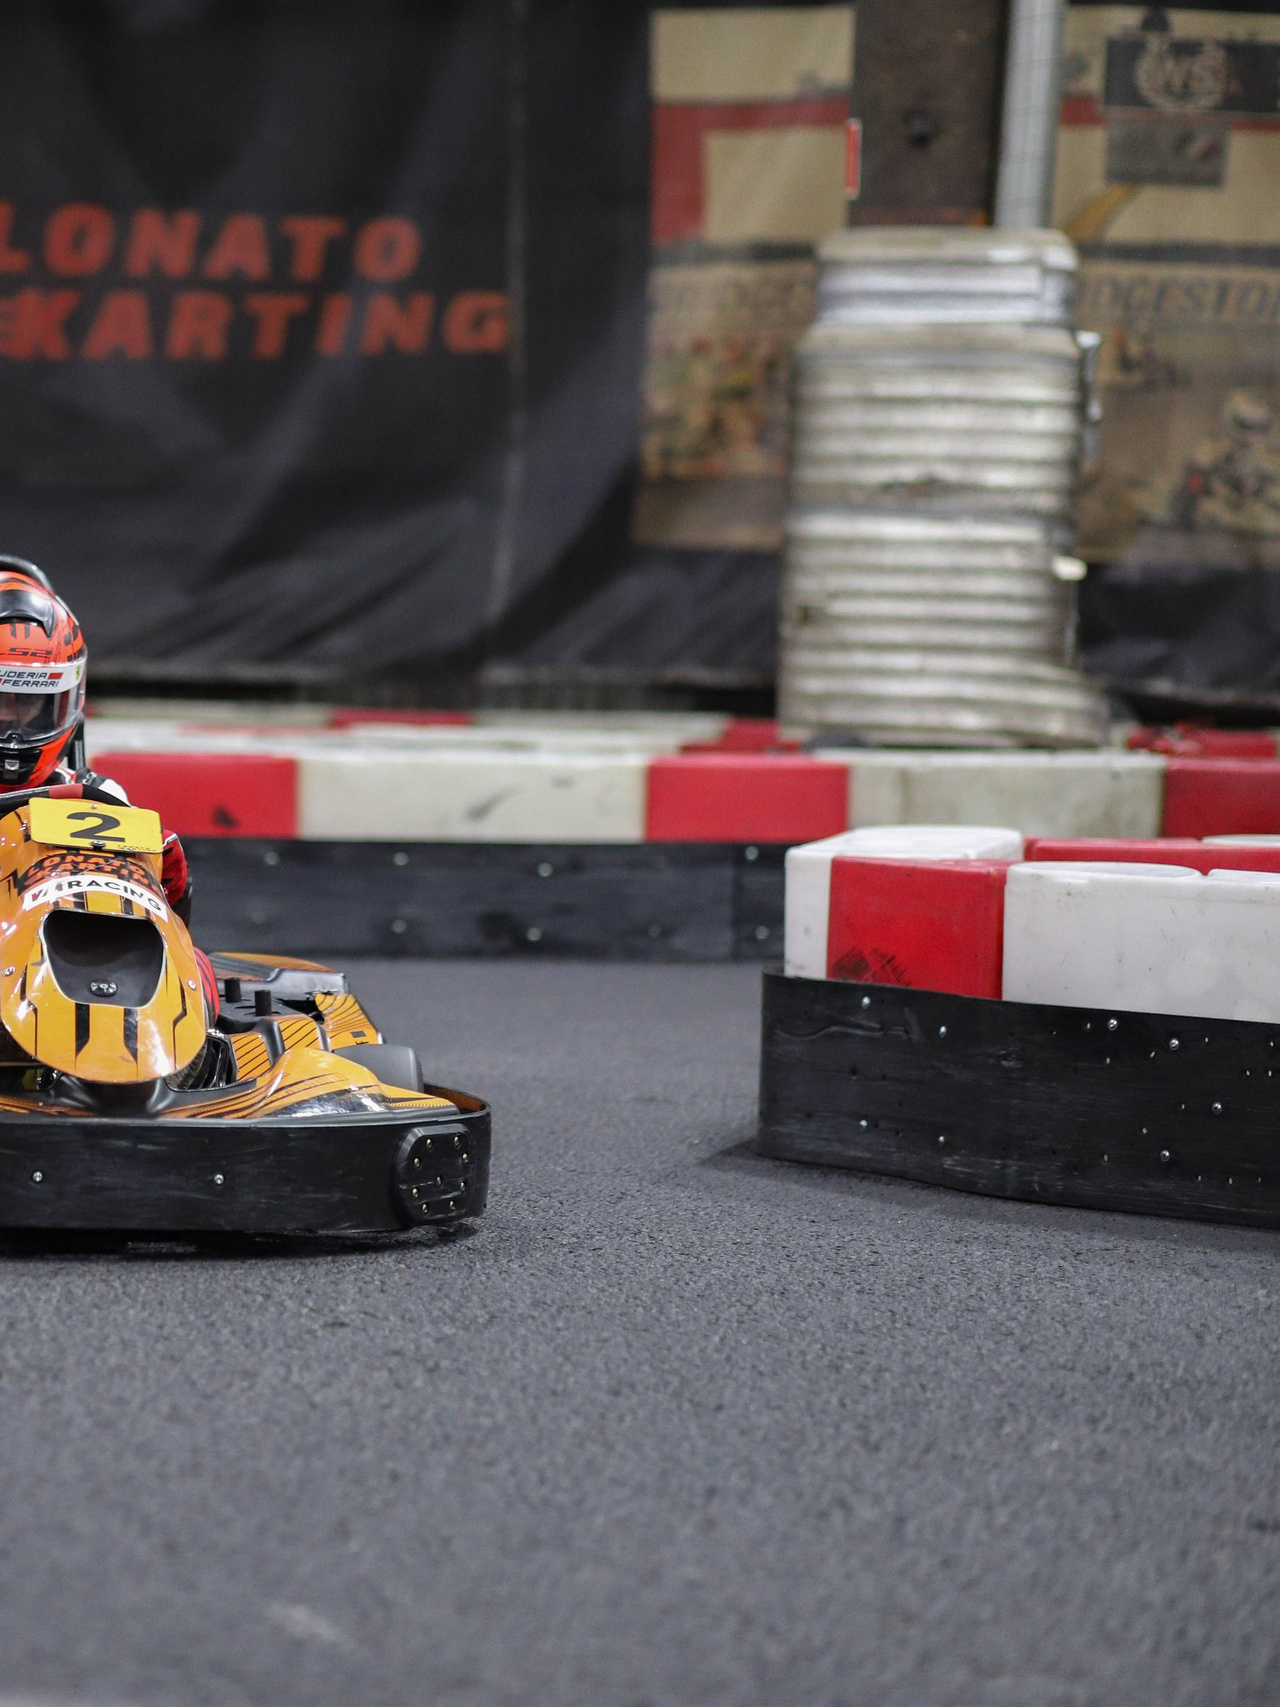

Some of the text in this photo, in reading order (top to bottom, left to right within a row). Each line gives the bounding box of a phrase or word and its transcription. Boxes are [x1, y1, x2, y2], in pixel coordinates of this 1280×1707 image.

[2, 288, 510, 361] KARTING
[1, 679, 60, 688] FERRARI
[66, 811, 125, 843] 2
[27, 854, 146, 877] LONATO
